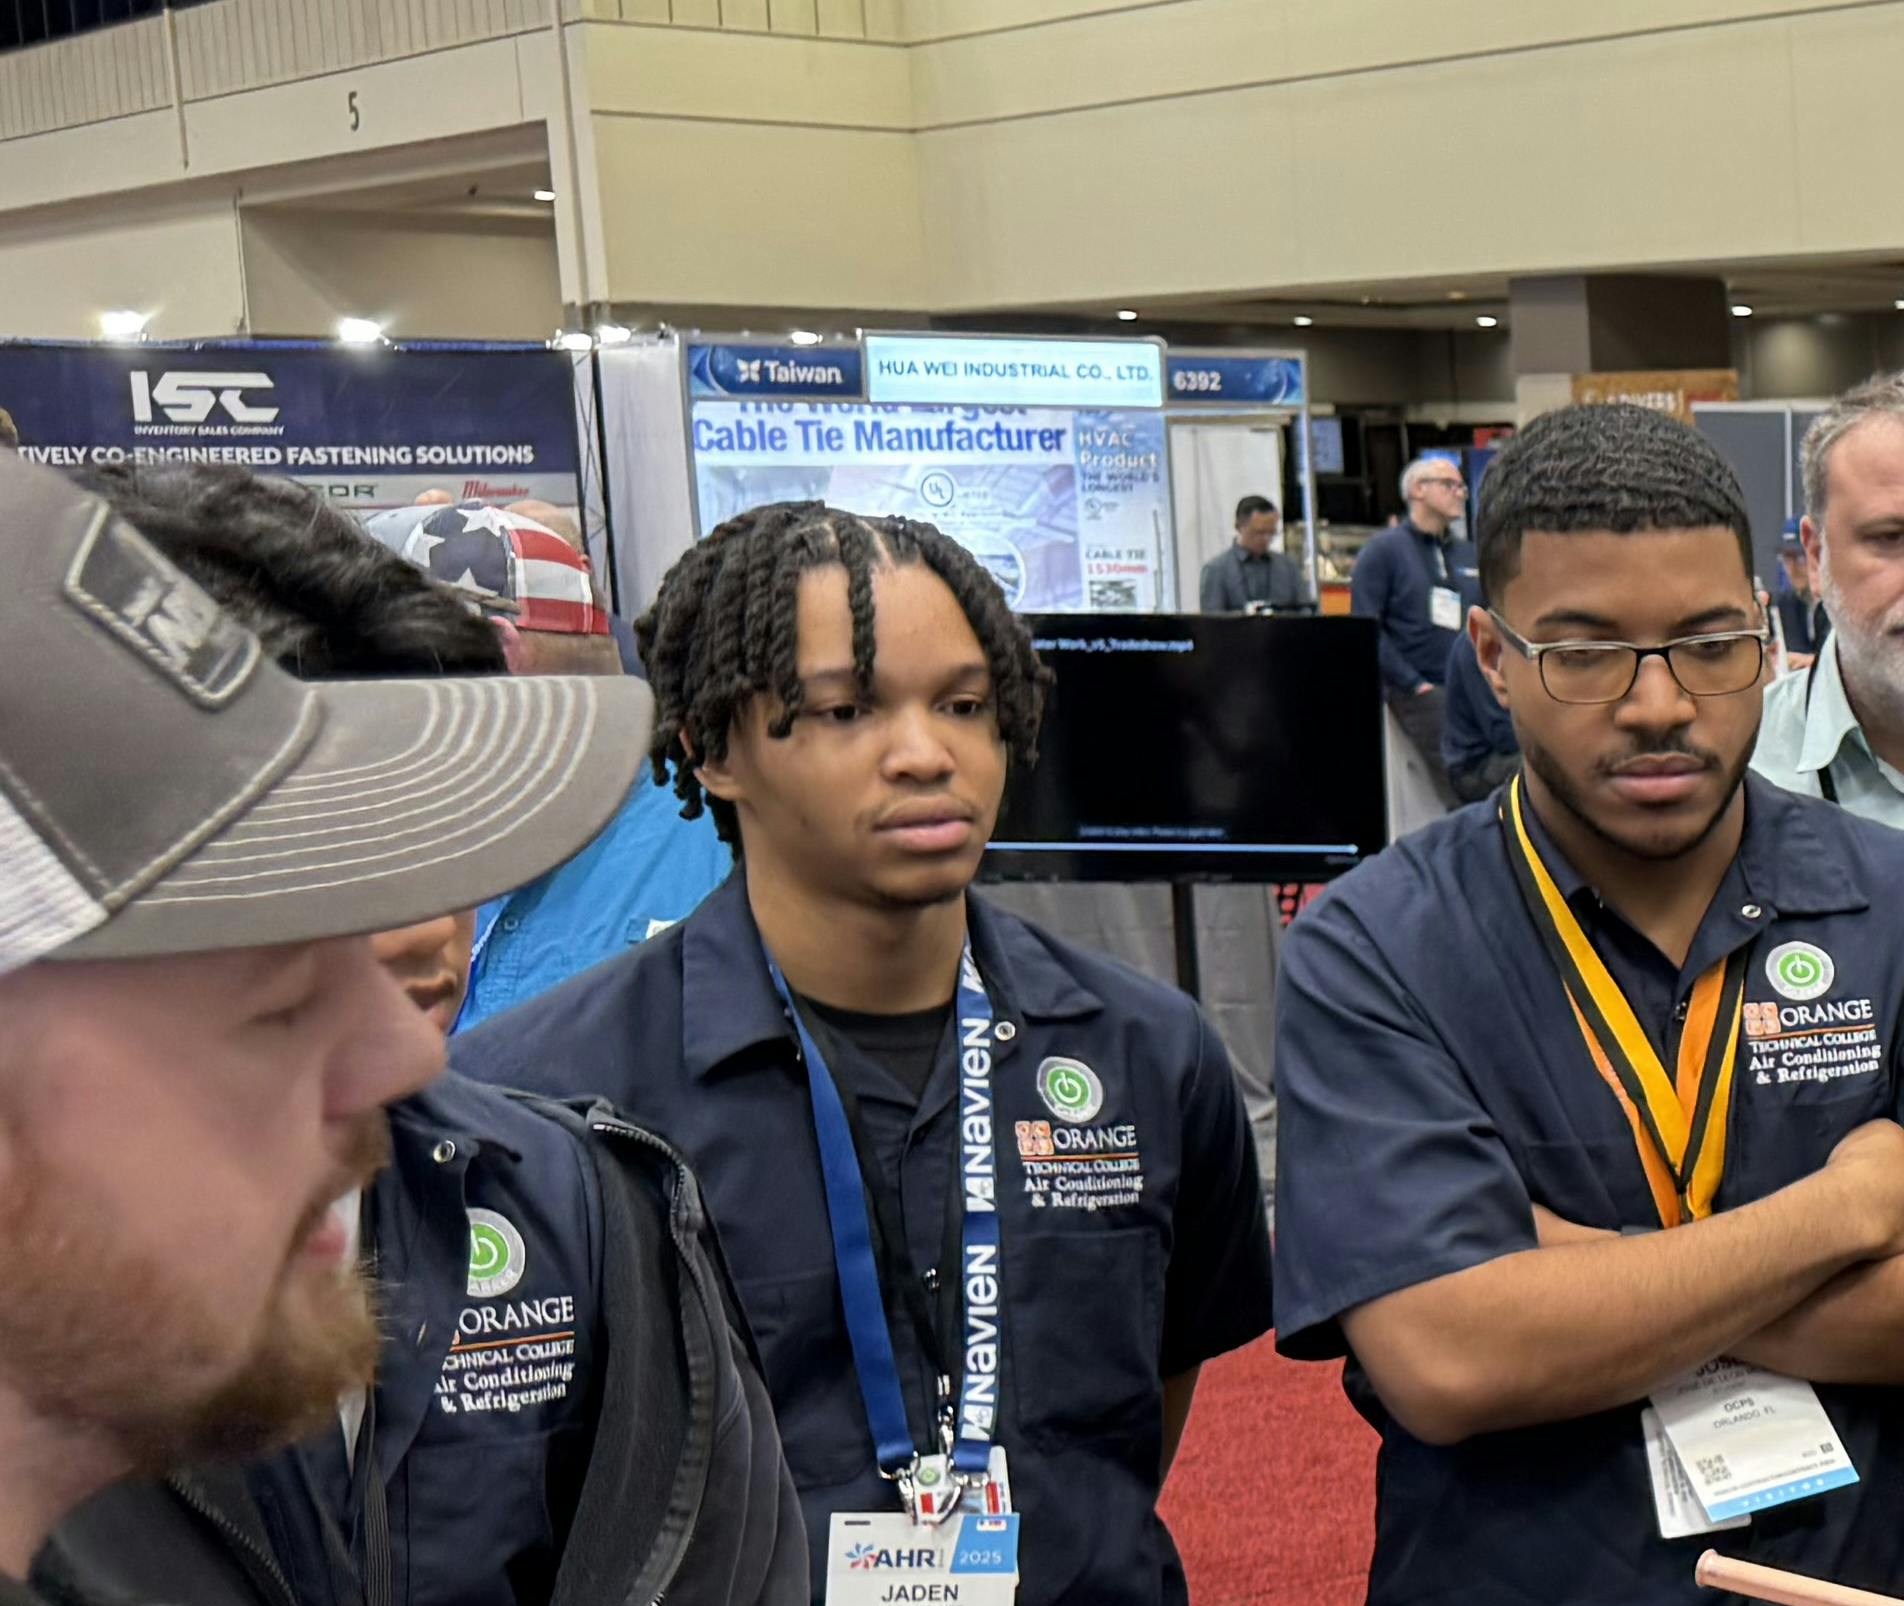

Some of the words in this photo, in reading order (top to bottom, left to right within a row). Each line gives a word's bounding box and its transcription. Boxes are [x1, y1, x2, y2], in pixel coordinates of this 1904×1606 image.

[348, 91, 360, 132] 5
[762, 358, 844, 385] Taiwan
[879, 360, 920, 376] HUA
[924, 361, 958, 376] WEI
[962, 362, 1071, 379] INDUSTRIAL
[1116, 366, 1154, 382] LTD.
[130, 371, 280, 423] ISC
[694, 420, 795, 452] Cable
[801, 420, 853, 452] Tie
[855, 422, 1067, 454] Manufacturer
[1078, 432, 1133, 448] HVAC
[90, 446, 282, 467] CO-ENGINEERED
[286, 446, 413, 466] FASTENING
[415, 445, 536, 466] SOLUTIONS
[1080, 451, 1158, 467] Product
[1780, 998, 1874, 1027] ORANGE
[1749, 1056, 1776, 1071] Air
[1782, 1045, 1882, 1067] Conditioning
[1756, 1071, 1772, 1085] &
[1777, 1060, 1879, 1083] Refrigeration
[1052, 1125, 1137, 1149] ORANGE
[1024, 1176, 1050, 1192] Air
[1055, 1174, 1144, 1192] Conditioning
[459, 1296, 575, 1334] ORANGE
[463, 1361, 576, 1391] Conditioning
[460, 1382, 567, 1413] Refrigeration
[873, 1549, 937, 1569] AHR
[959, 1551, 1002, 1566] 2025
[881, 1584, 960, 1602] JADEN
